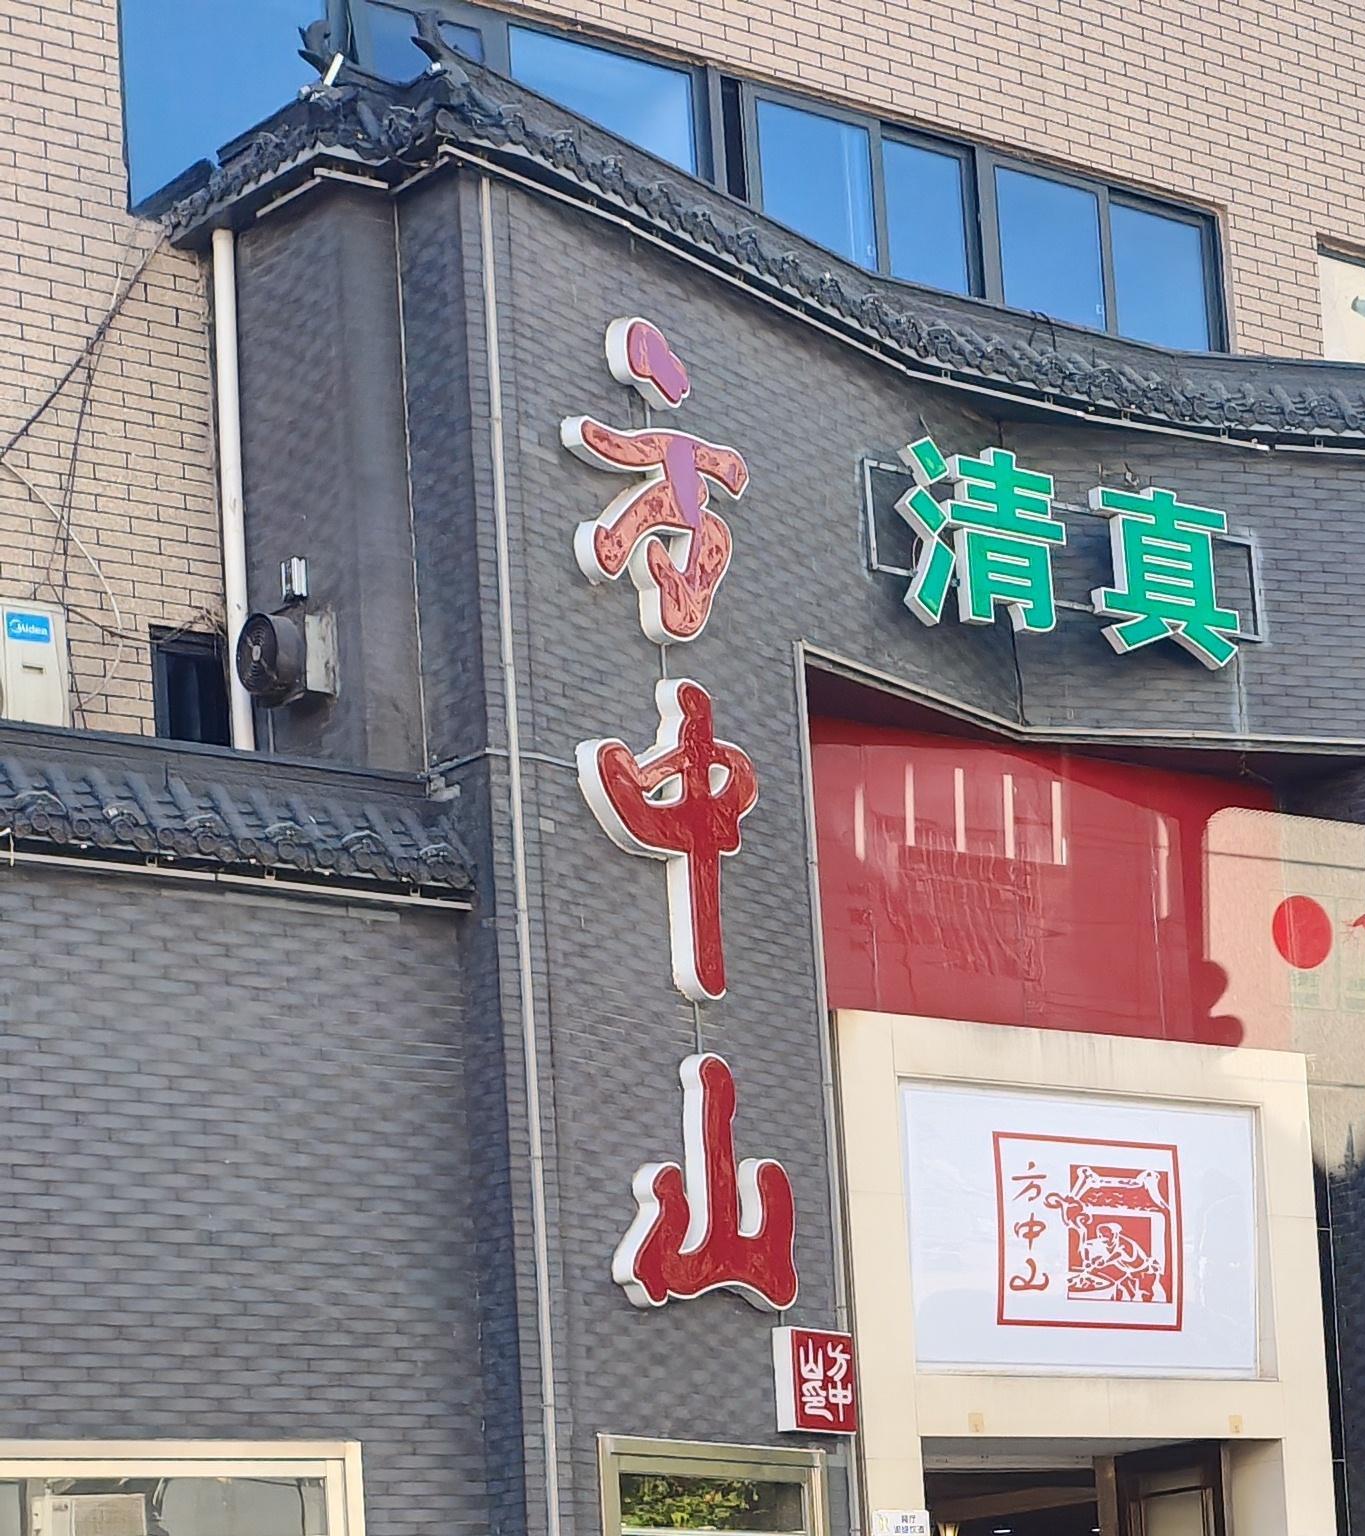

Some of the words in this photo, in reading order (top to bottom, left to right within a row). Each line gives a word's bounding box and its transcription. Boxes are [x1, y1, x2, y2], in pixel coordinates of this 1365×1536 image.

[895, 436, 1239, 669] 清真
[561, 316, 798, 1311] 方中山
[1009, 1161, 1050, 1291] 方中山
